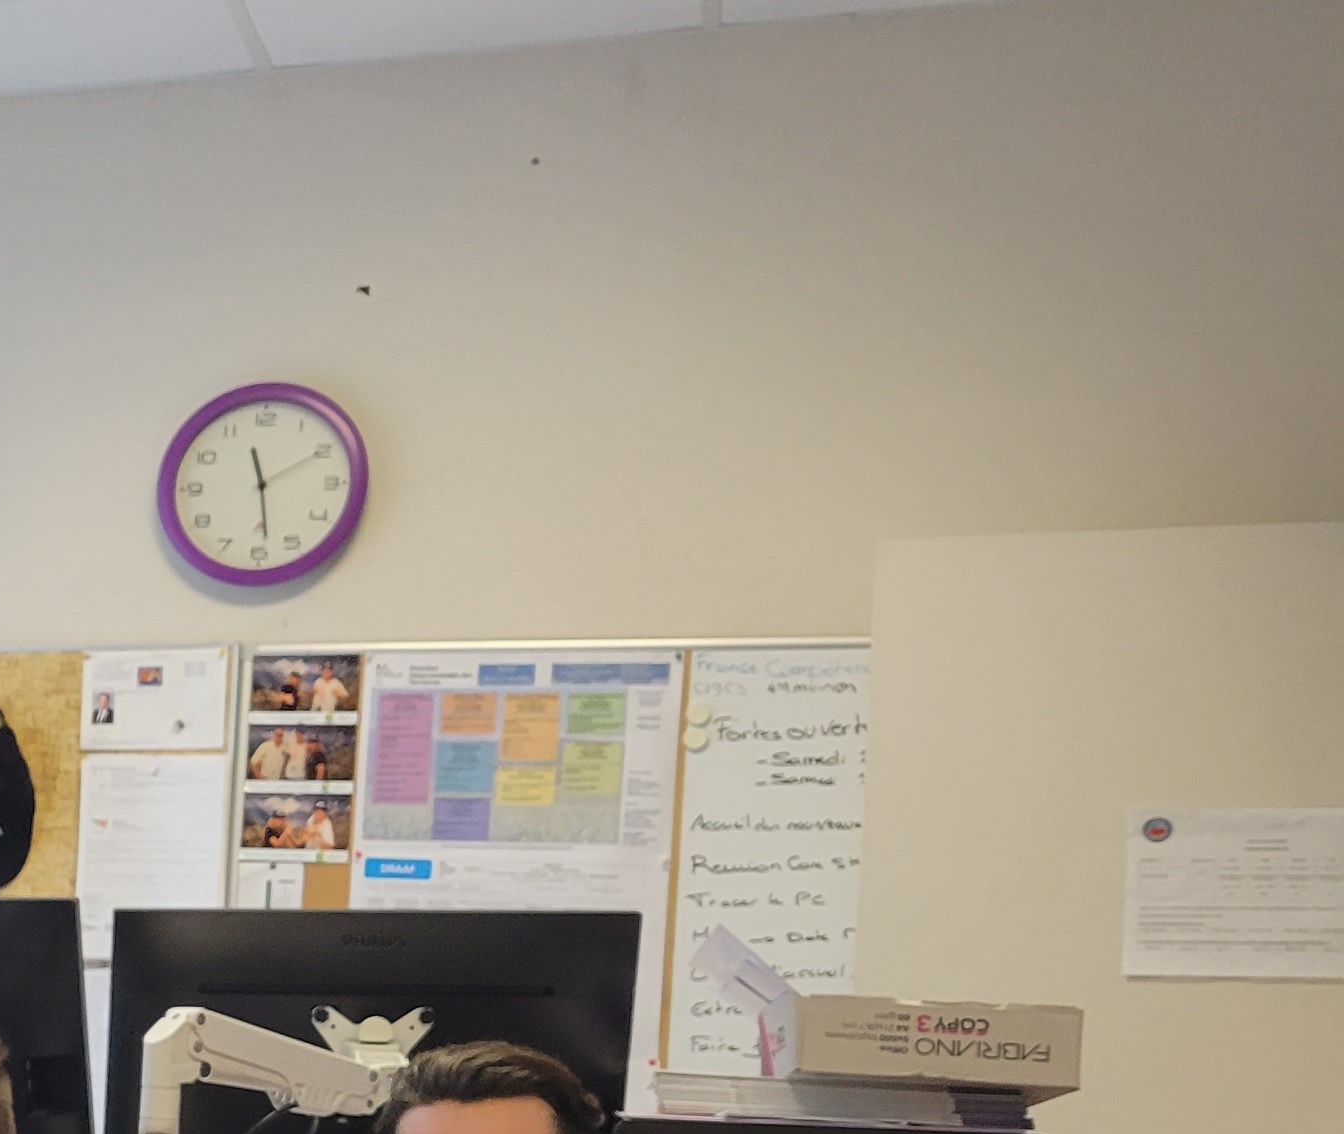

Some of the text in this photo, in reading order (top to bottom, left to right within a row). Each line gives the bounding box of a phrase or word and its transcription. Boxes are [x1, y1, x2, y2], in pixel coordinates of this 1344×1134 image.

[256, 412, 276, 427] 12
[299, 419, 304, 432] 1
[224, 425, 237, 438] 11
[198, 451, 217, 465] 10
[187, 482, 203, 497] 9
[324, 475, 339, 491] 3
[195, 514, 210, 528] 8
[218, 538, 233, 551] 7
[284, 535, 301, 550] 5
[917, 1014, 932, 1034] 3
[934, 1017, 990, 1035] COPY
[915, 1038, 1051, 1063] FABRIANO
